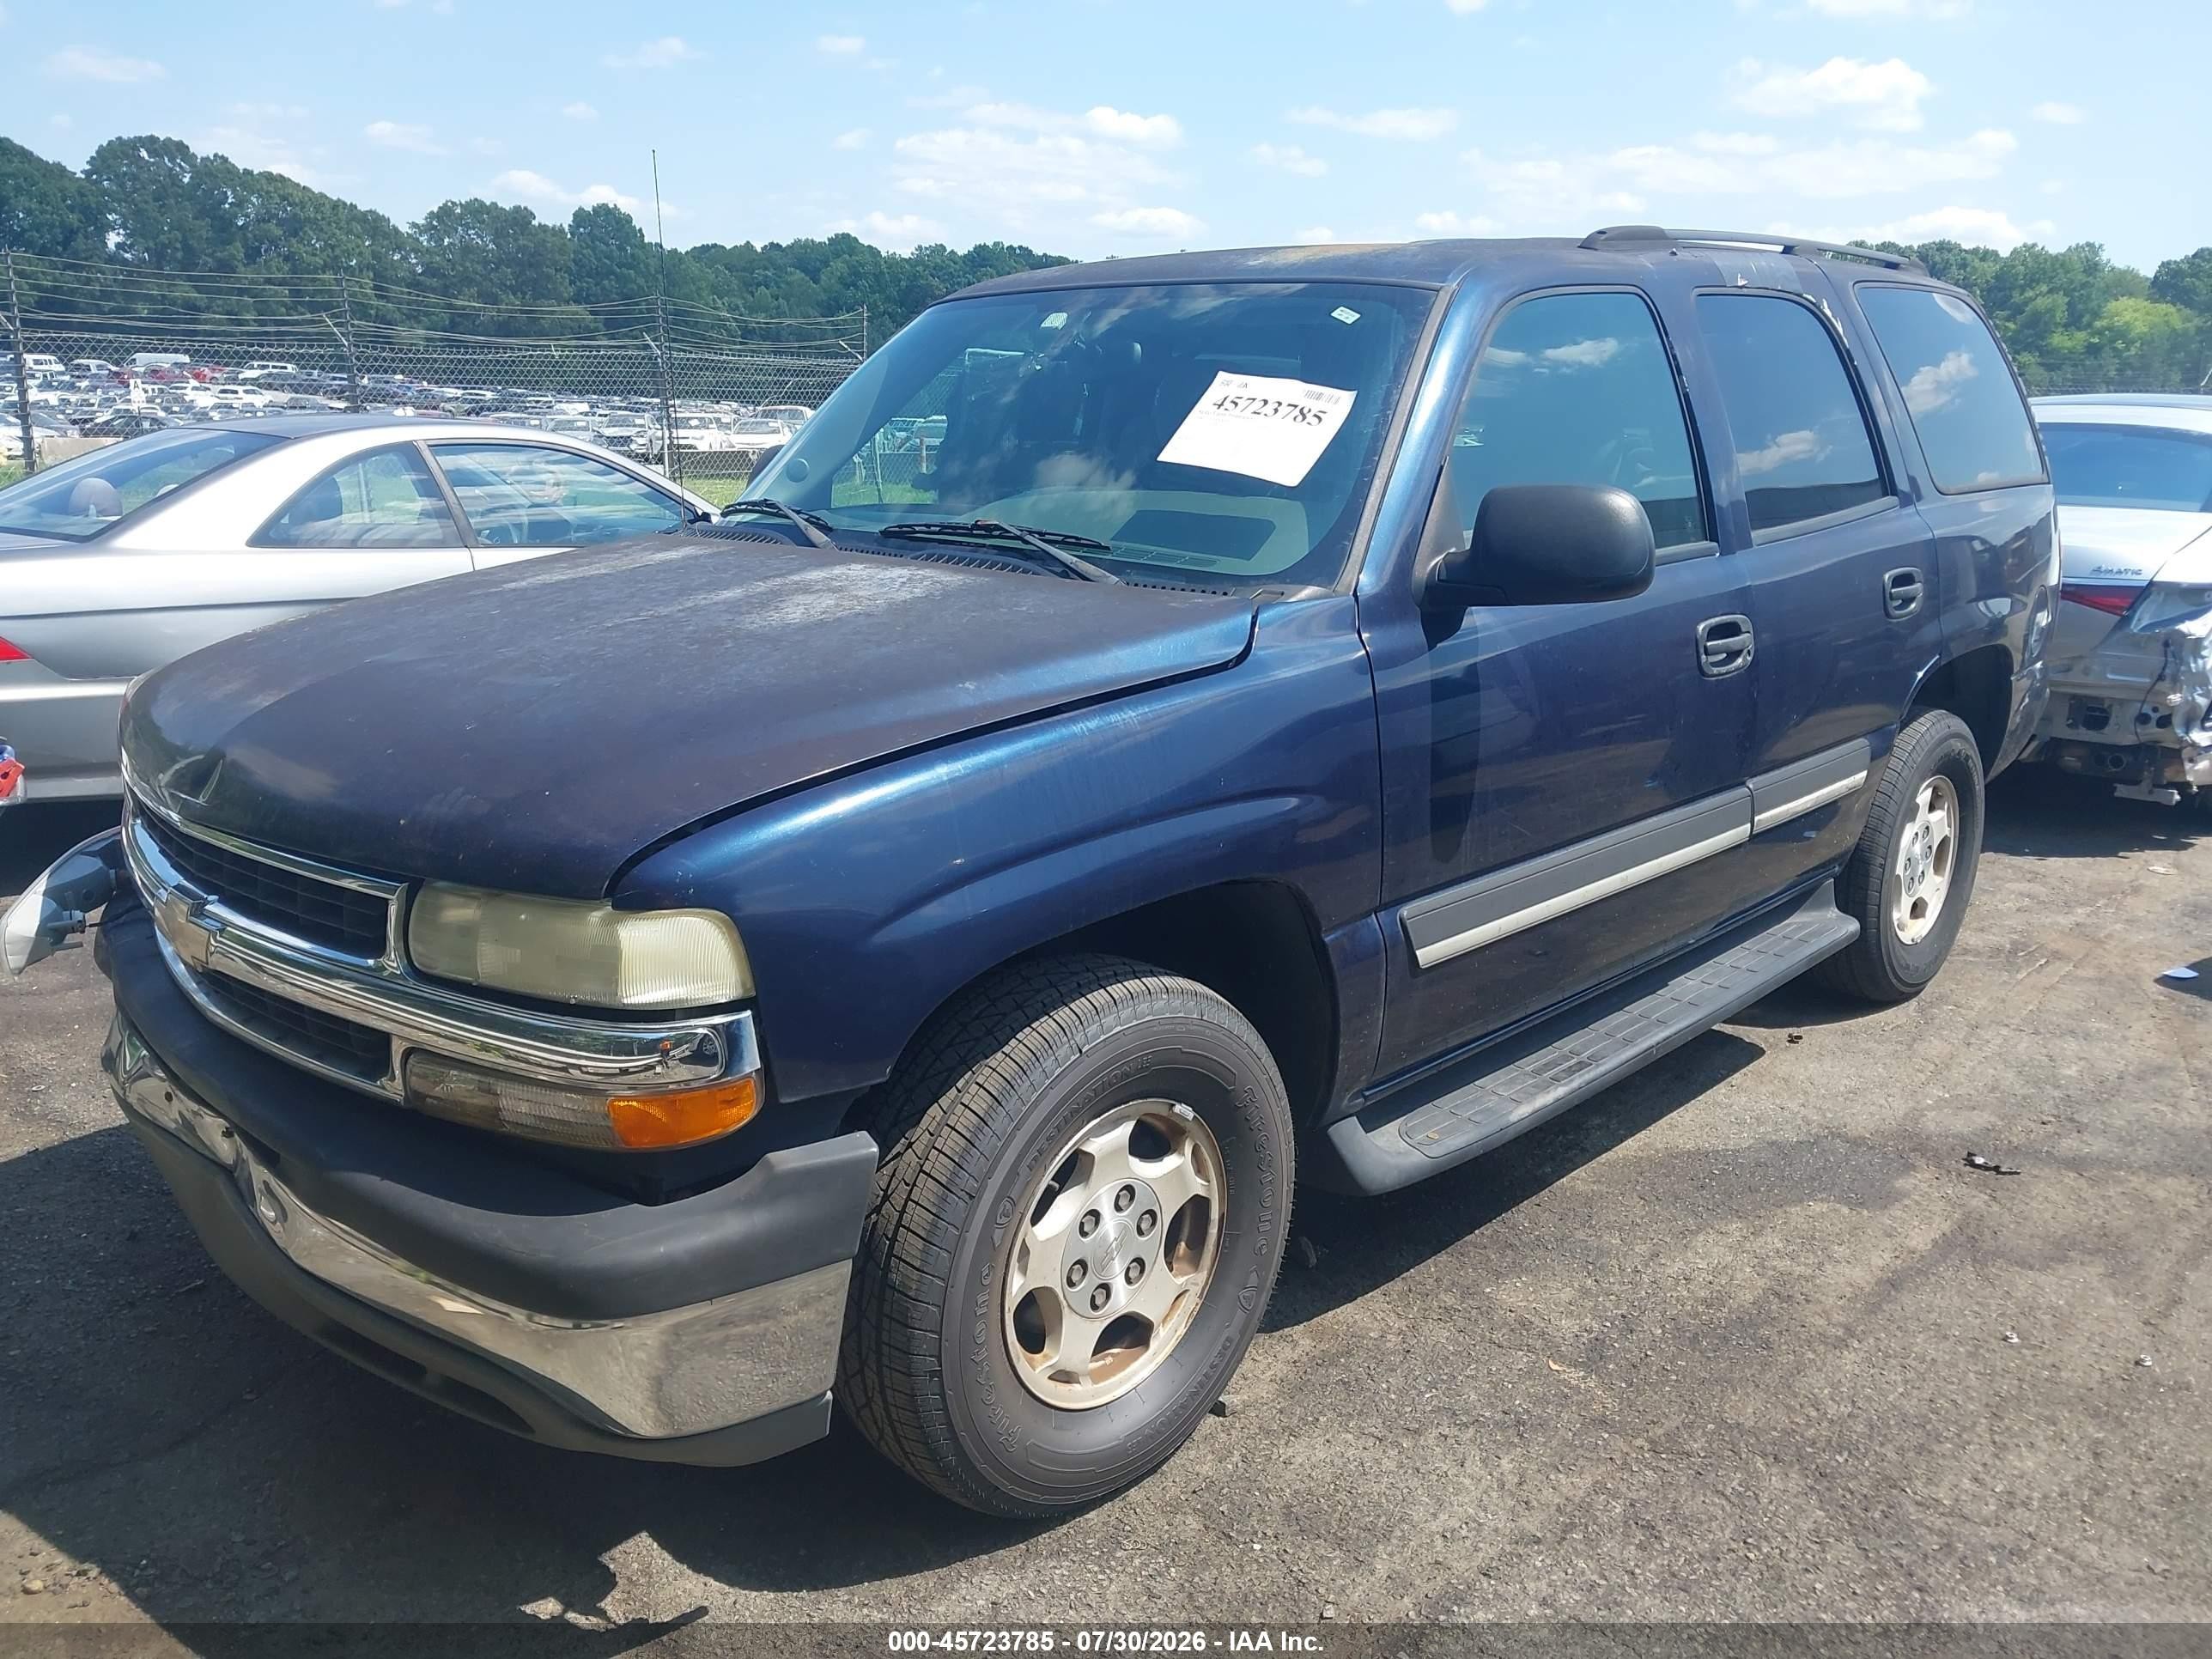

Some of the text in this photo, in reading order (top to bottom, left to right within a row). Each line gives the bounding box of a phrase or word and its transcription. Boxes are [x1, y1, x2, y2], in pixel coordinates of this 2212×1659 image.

[1212, 394, 1329, 428] 45723785
[2089, 564, 2143, 576] 4MATIC
[1236, 1085, 1277, 1257] Firestone
[969, 1262, 1023, 1453] Firestone
